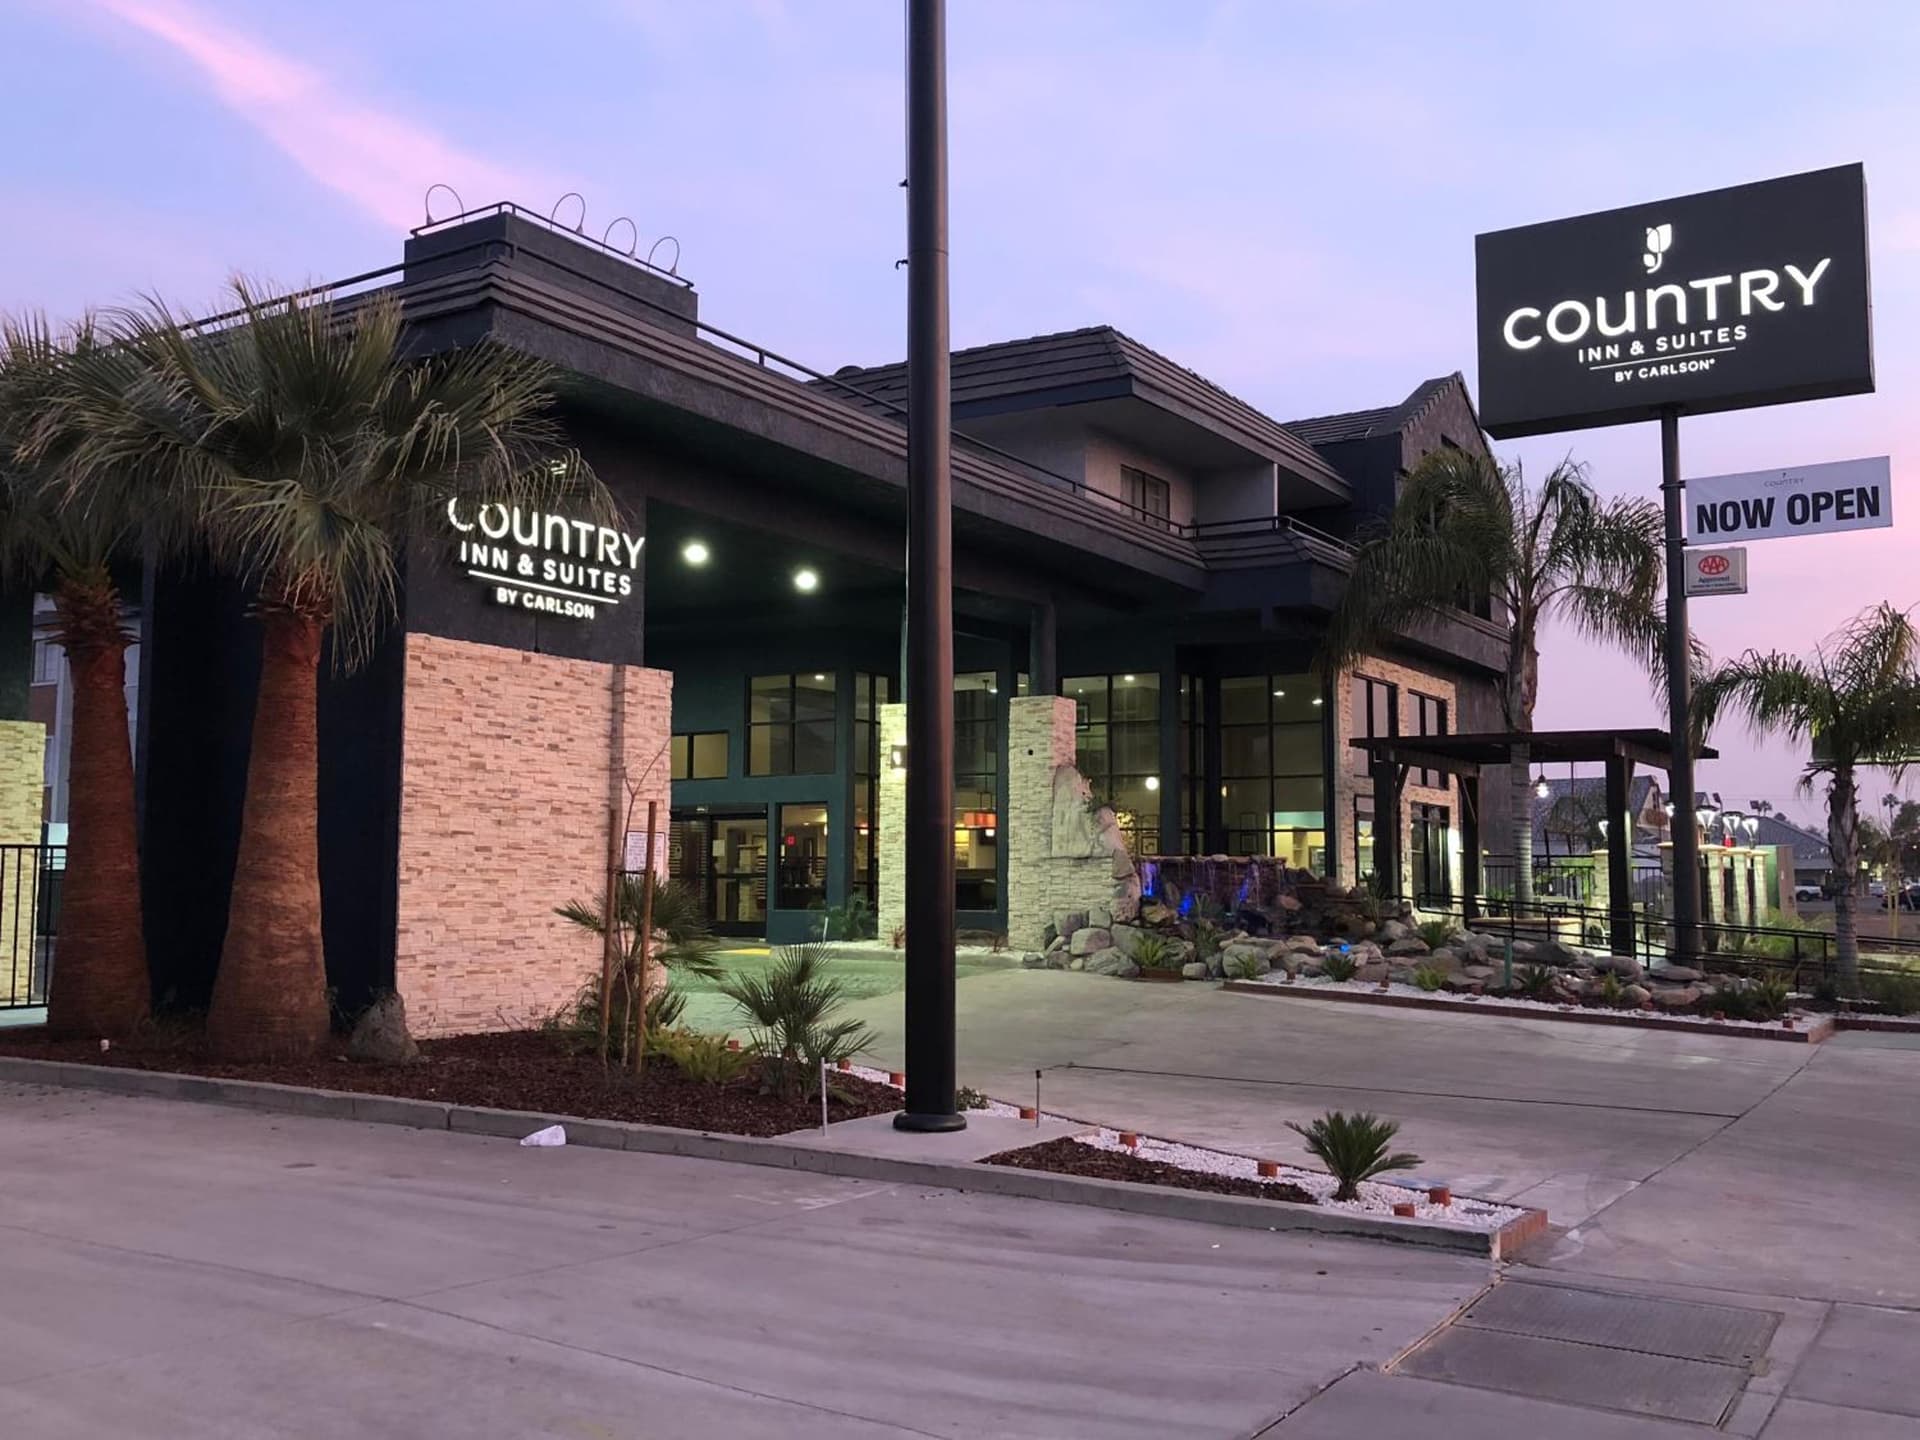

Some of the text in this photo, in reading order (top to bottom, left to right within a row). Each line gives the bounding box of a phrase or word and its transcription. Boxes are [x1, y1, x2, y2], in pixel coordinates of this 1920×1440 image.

[1503, 257, 1832, 350] COUNTRY
[1578, 324, 1747, 364] INN & SUITES
[1614, 370, 1633, 382] BY
[1696, 486, 1880, 534] NOW OPEN
[460, 540, 632, 596] INN & SUITES
[1701, 556, 1727, 574] AAA
[496, 586, 596, 620] BY CARLSON
